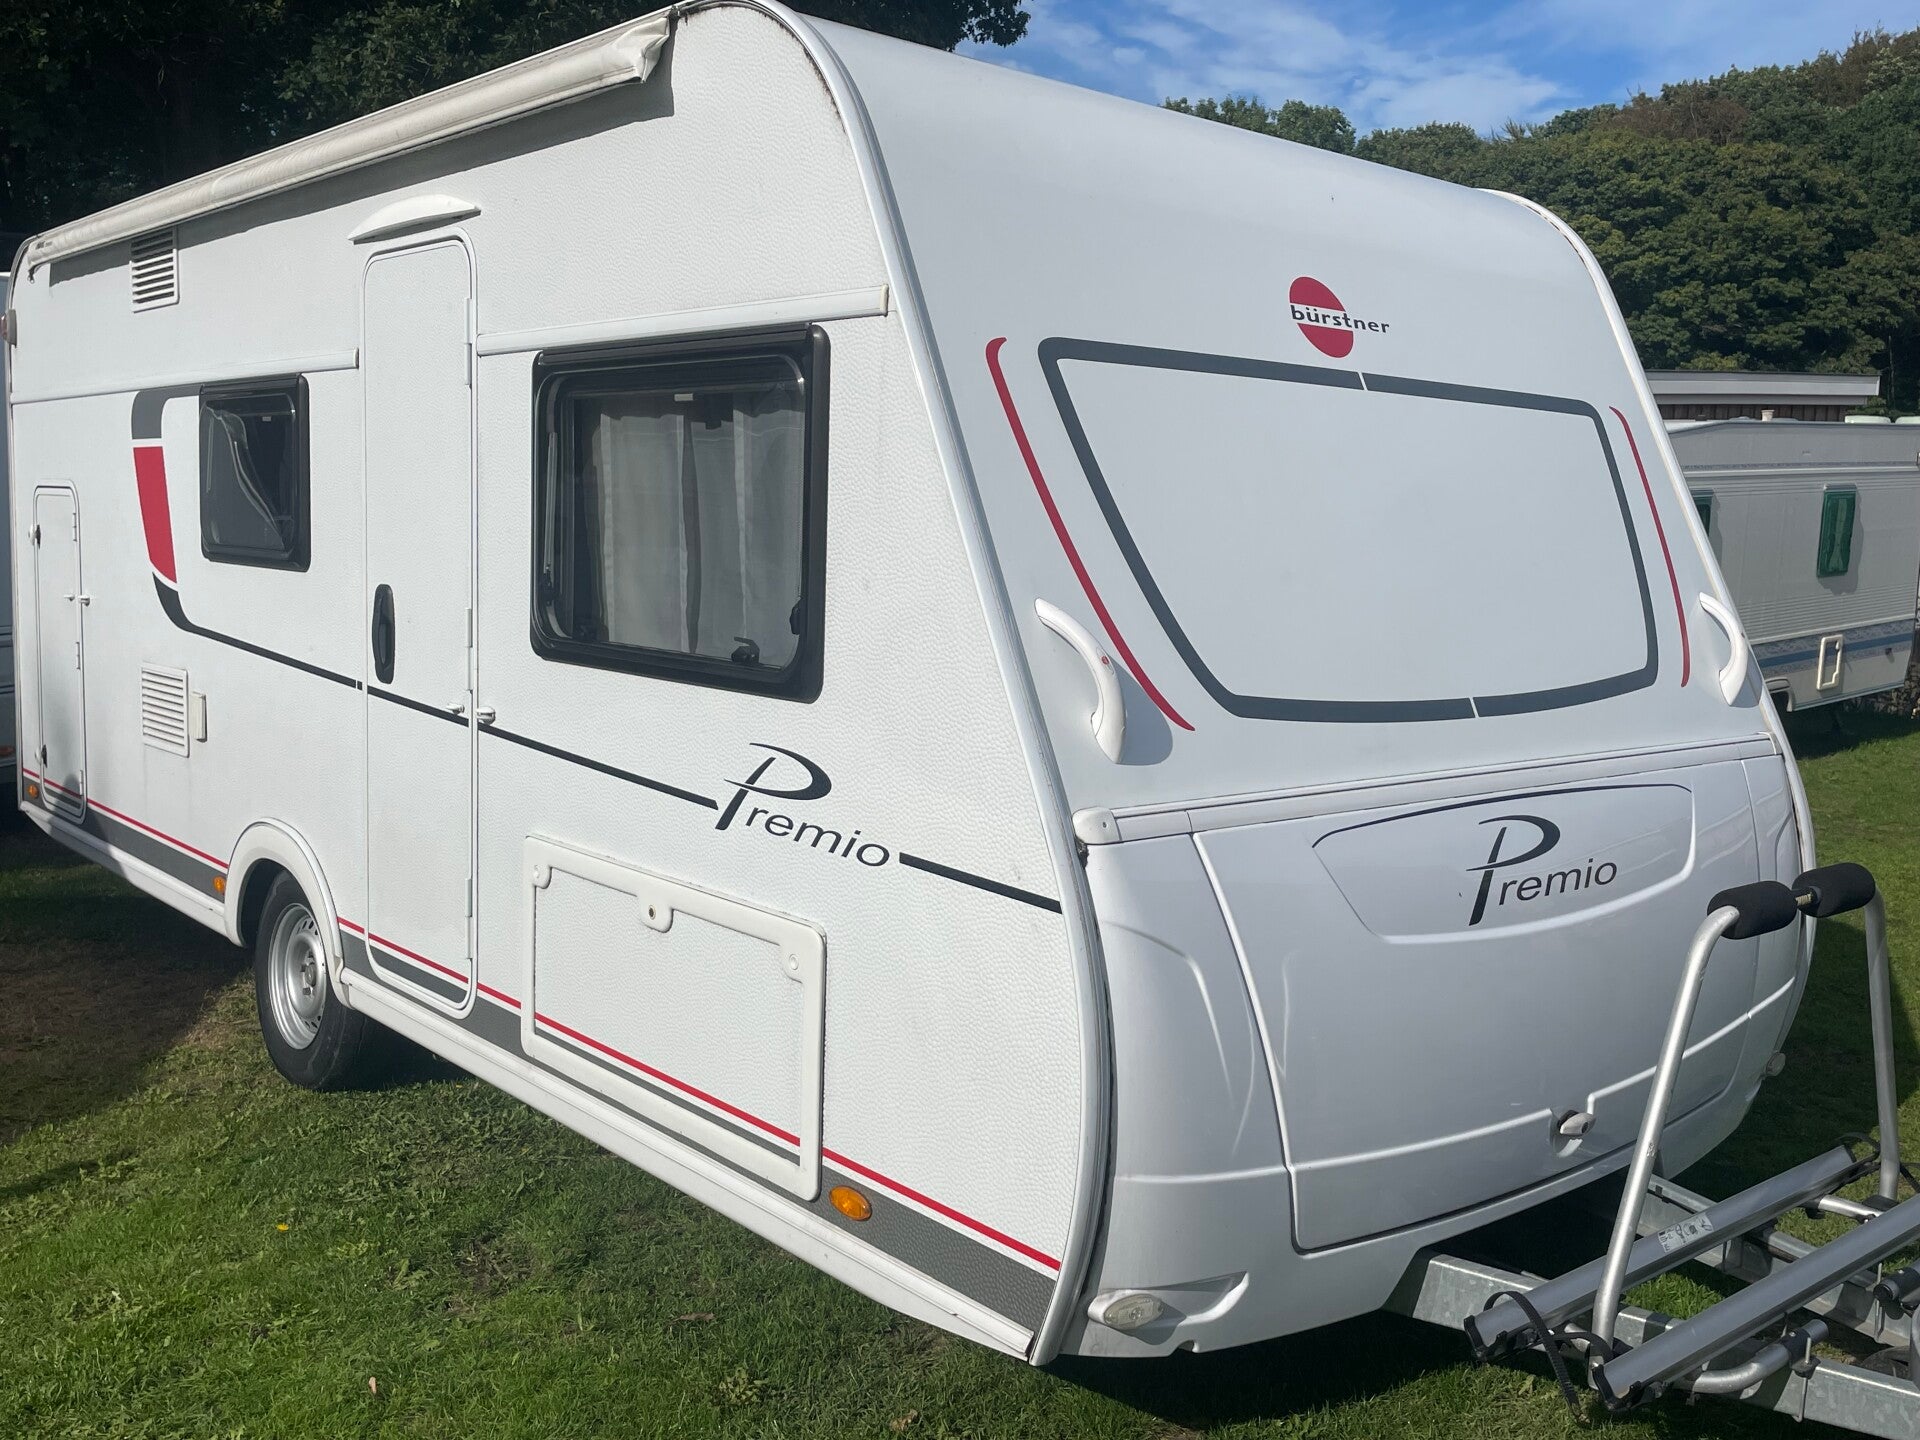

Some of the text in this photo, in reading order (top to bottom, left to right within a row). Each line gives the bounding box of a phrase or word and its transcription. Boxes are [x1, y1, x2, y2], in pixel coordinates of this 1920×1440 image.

[1290, 304, 1390, 333] bürstner
[714, 742, 890, 867] Premio
[1465, 814, 1618, 926] Premio
